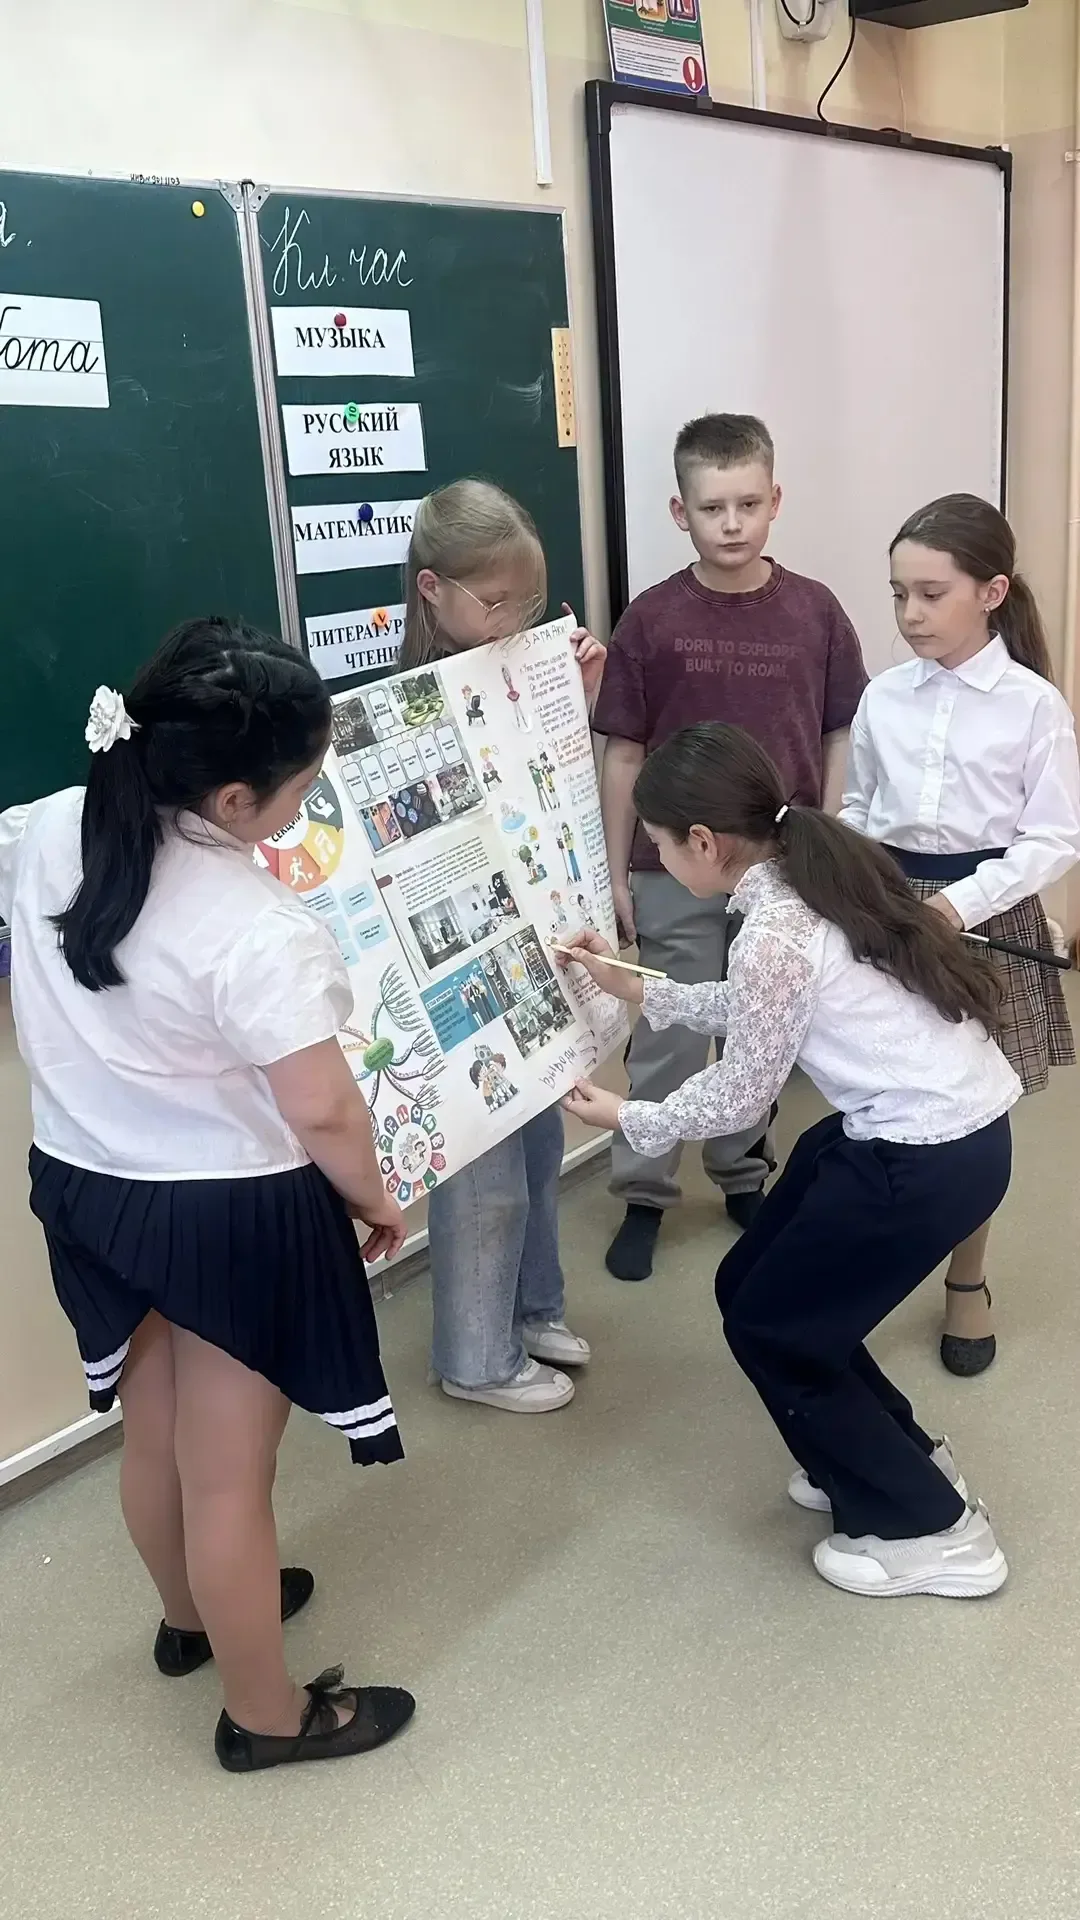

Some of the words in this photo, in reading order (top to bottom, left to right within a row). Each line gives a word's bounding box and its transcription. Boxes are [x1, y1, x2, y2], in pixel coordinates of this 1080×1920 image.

[350, 245, 414, 287] час
[295, 327, 386, 349] МУЗЫКА
[303, 406, 400, 435] РУССКИЙ
[329, 446, 384, 469] ЯЗЫК
[674, 637, 713, 652] BORN
[717, 640, 735, 654] TO
[685, 657, 723, 673] BUILT
[727, 660, 744, 677] TO
[271, 811, 304, 843] СЕКЦИИ
